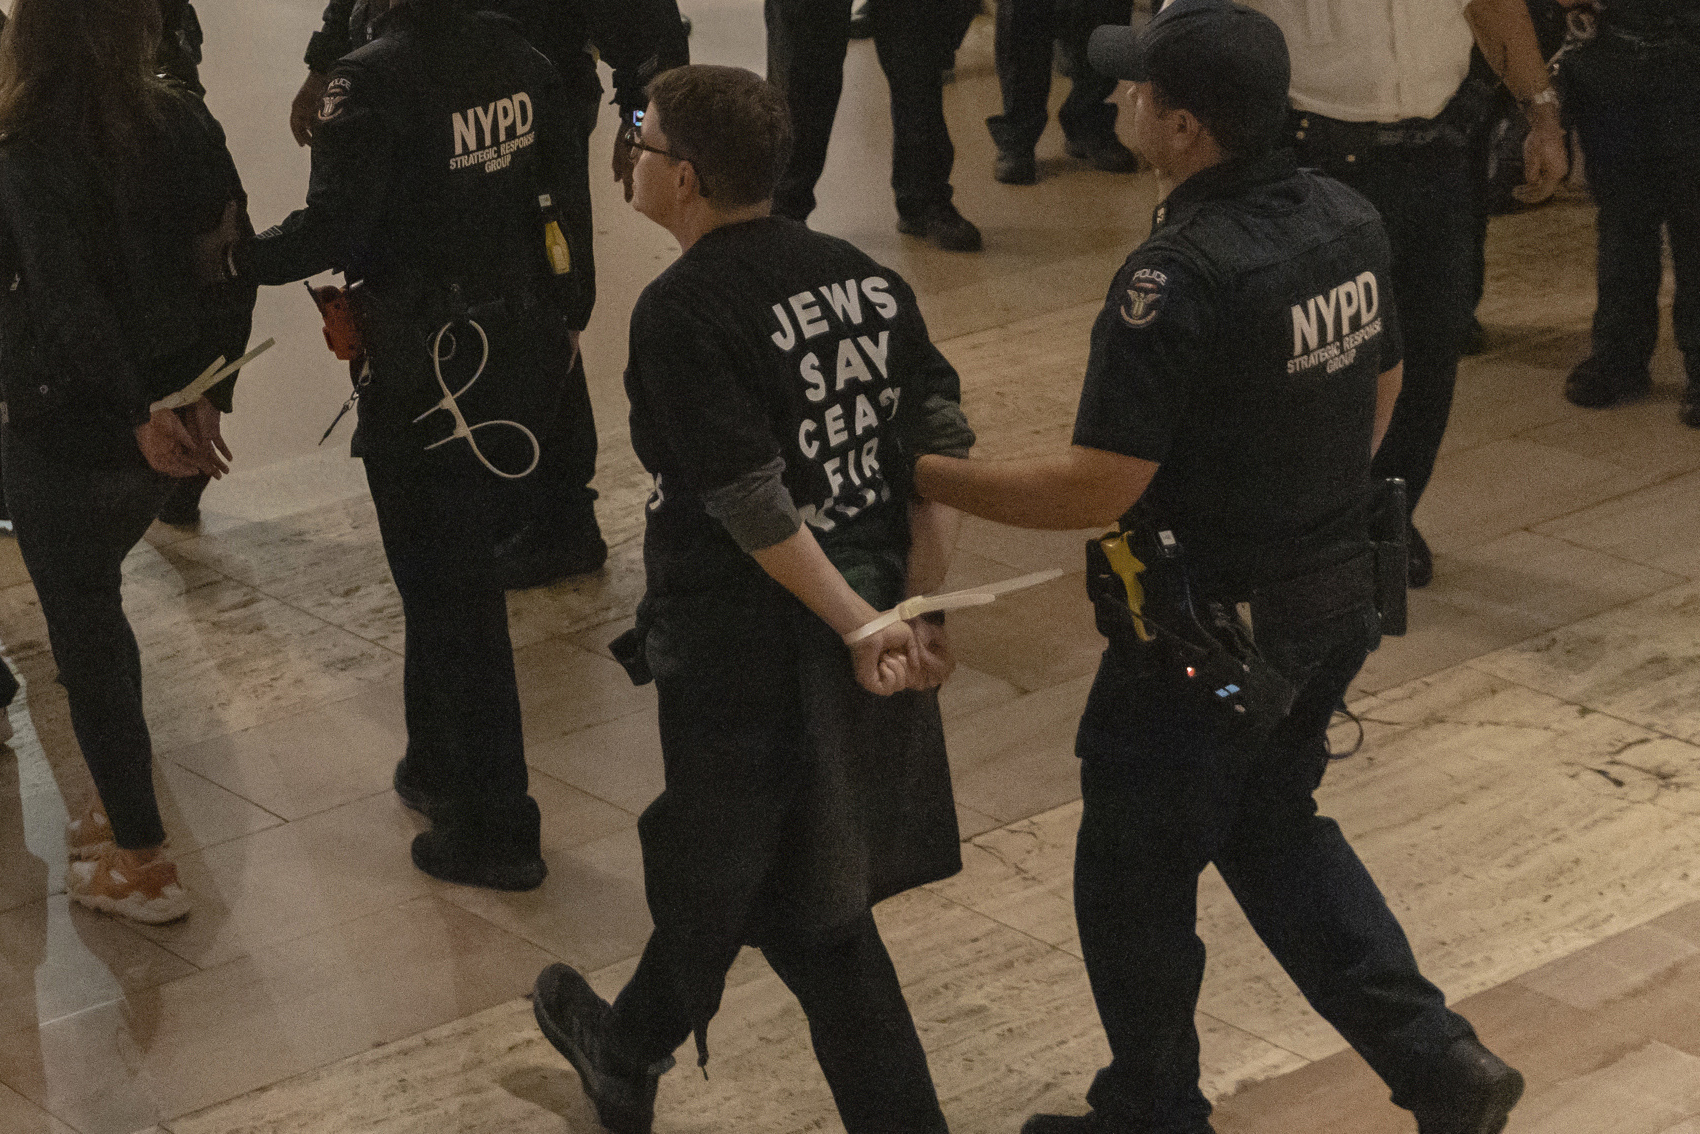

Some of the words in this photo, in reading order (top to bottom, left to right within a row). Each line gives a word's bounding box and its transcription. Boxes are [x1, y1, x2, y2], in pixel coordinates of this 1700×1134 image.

[451, 90, 535, 156] NYPD
[448, 146, 499, 171] STRATEGIC
[484, 153, 513, 174] GROUP
[1131, 267, 1169, 288] POLICE
[770, 275, 899, 352] JEWS
[1290, 269, 1380, 358] NYPD
[798, 330, 892, 403] SAY
[1285, 341, 1342, 375] STRATEGIC
[1325, 347, 1357, 375] GROUP
